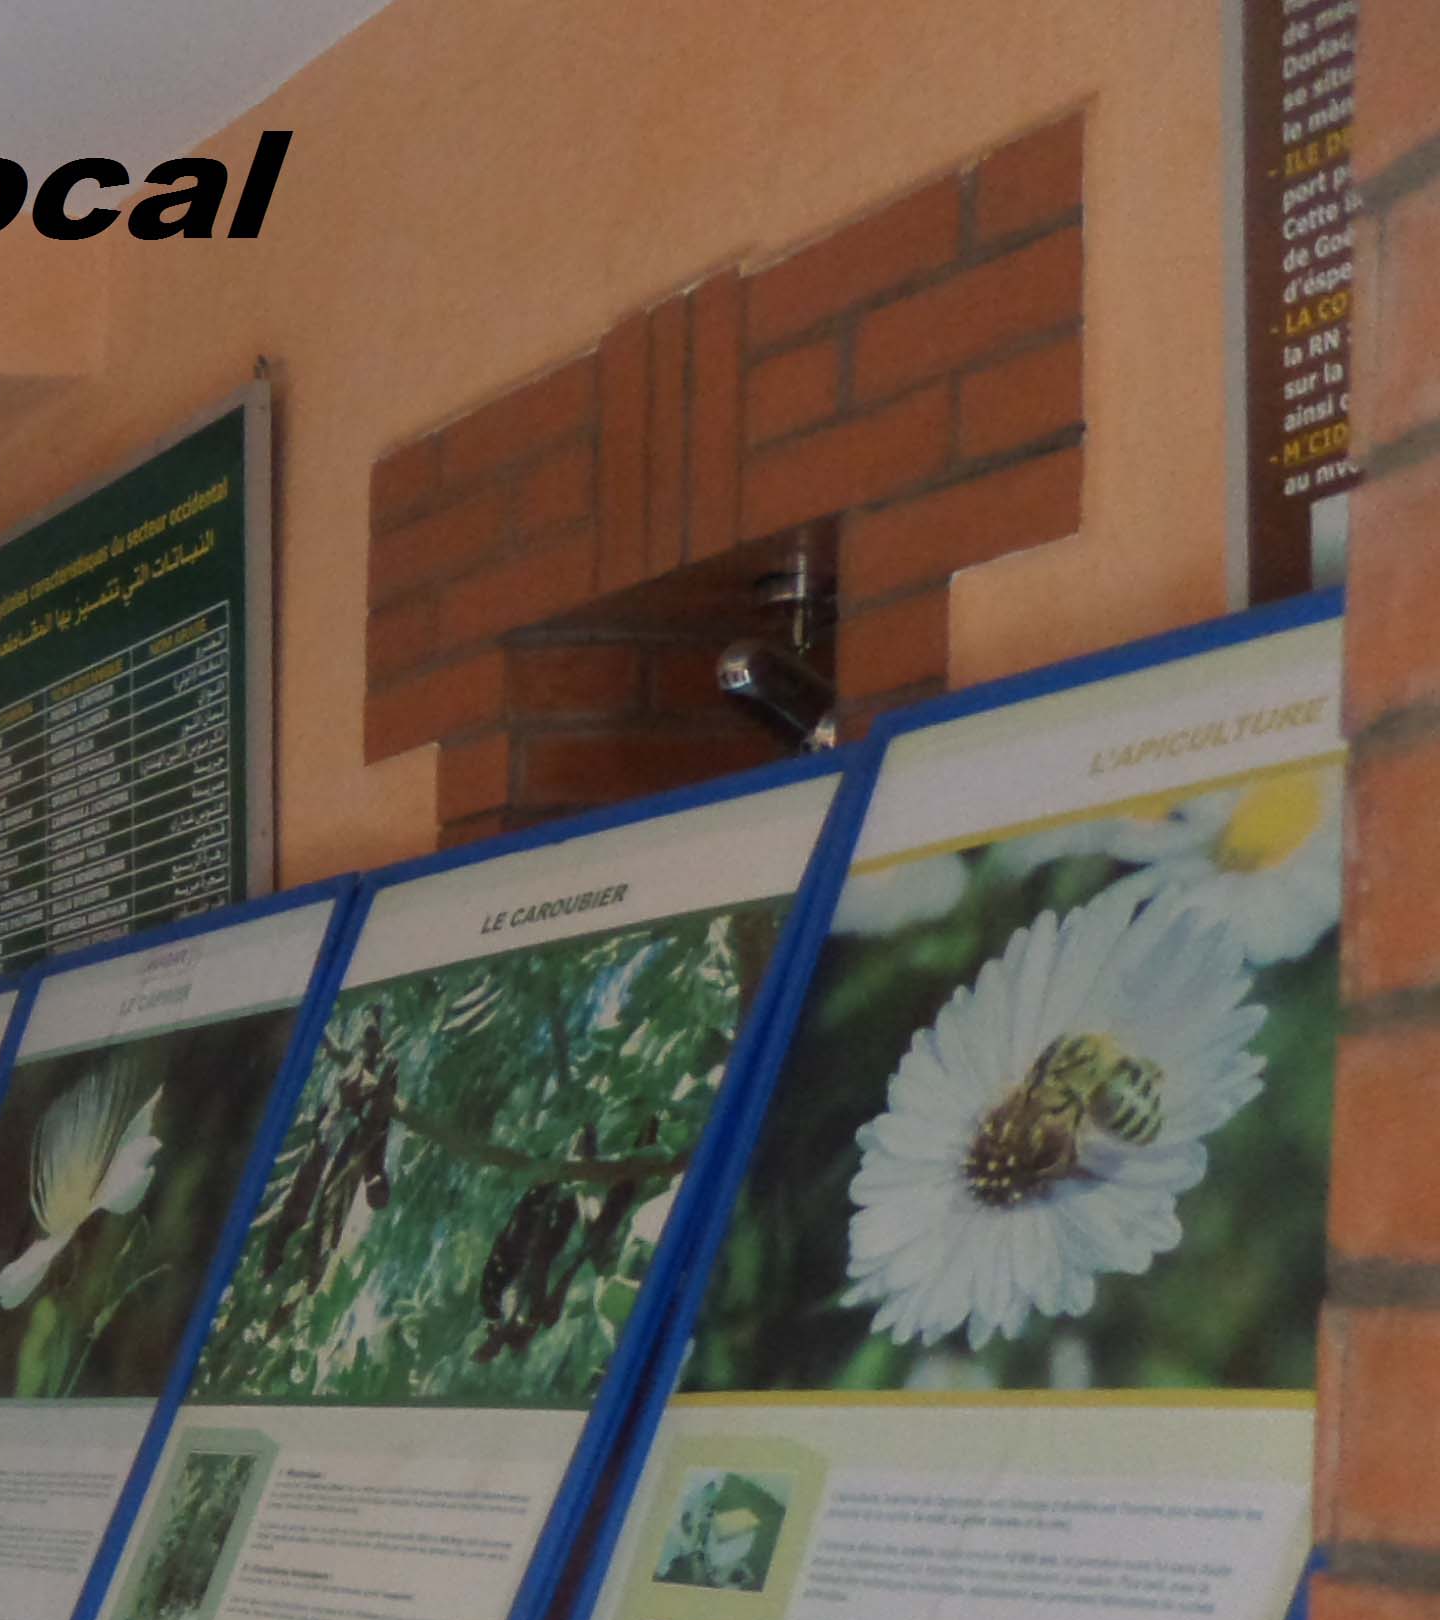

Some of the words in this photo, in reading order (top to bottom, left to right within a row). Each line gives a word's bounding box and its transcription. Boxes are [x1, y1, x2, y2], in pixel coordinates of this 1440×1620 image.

[1309, 327, 1341, 358] RN
[1283, 372, 1318, 400] sur
[1323, 362, 1344, 385] la
[1283, 393, 1335, 432] ainsi
[1283, 473, 1310, 496] au
[1087, 696, 1329, 777] L'APICULTURE
[480, 913, 505, 936] LE
[510, 882, 630, 928] CAROUBIER
